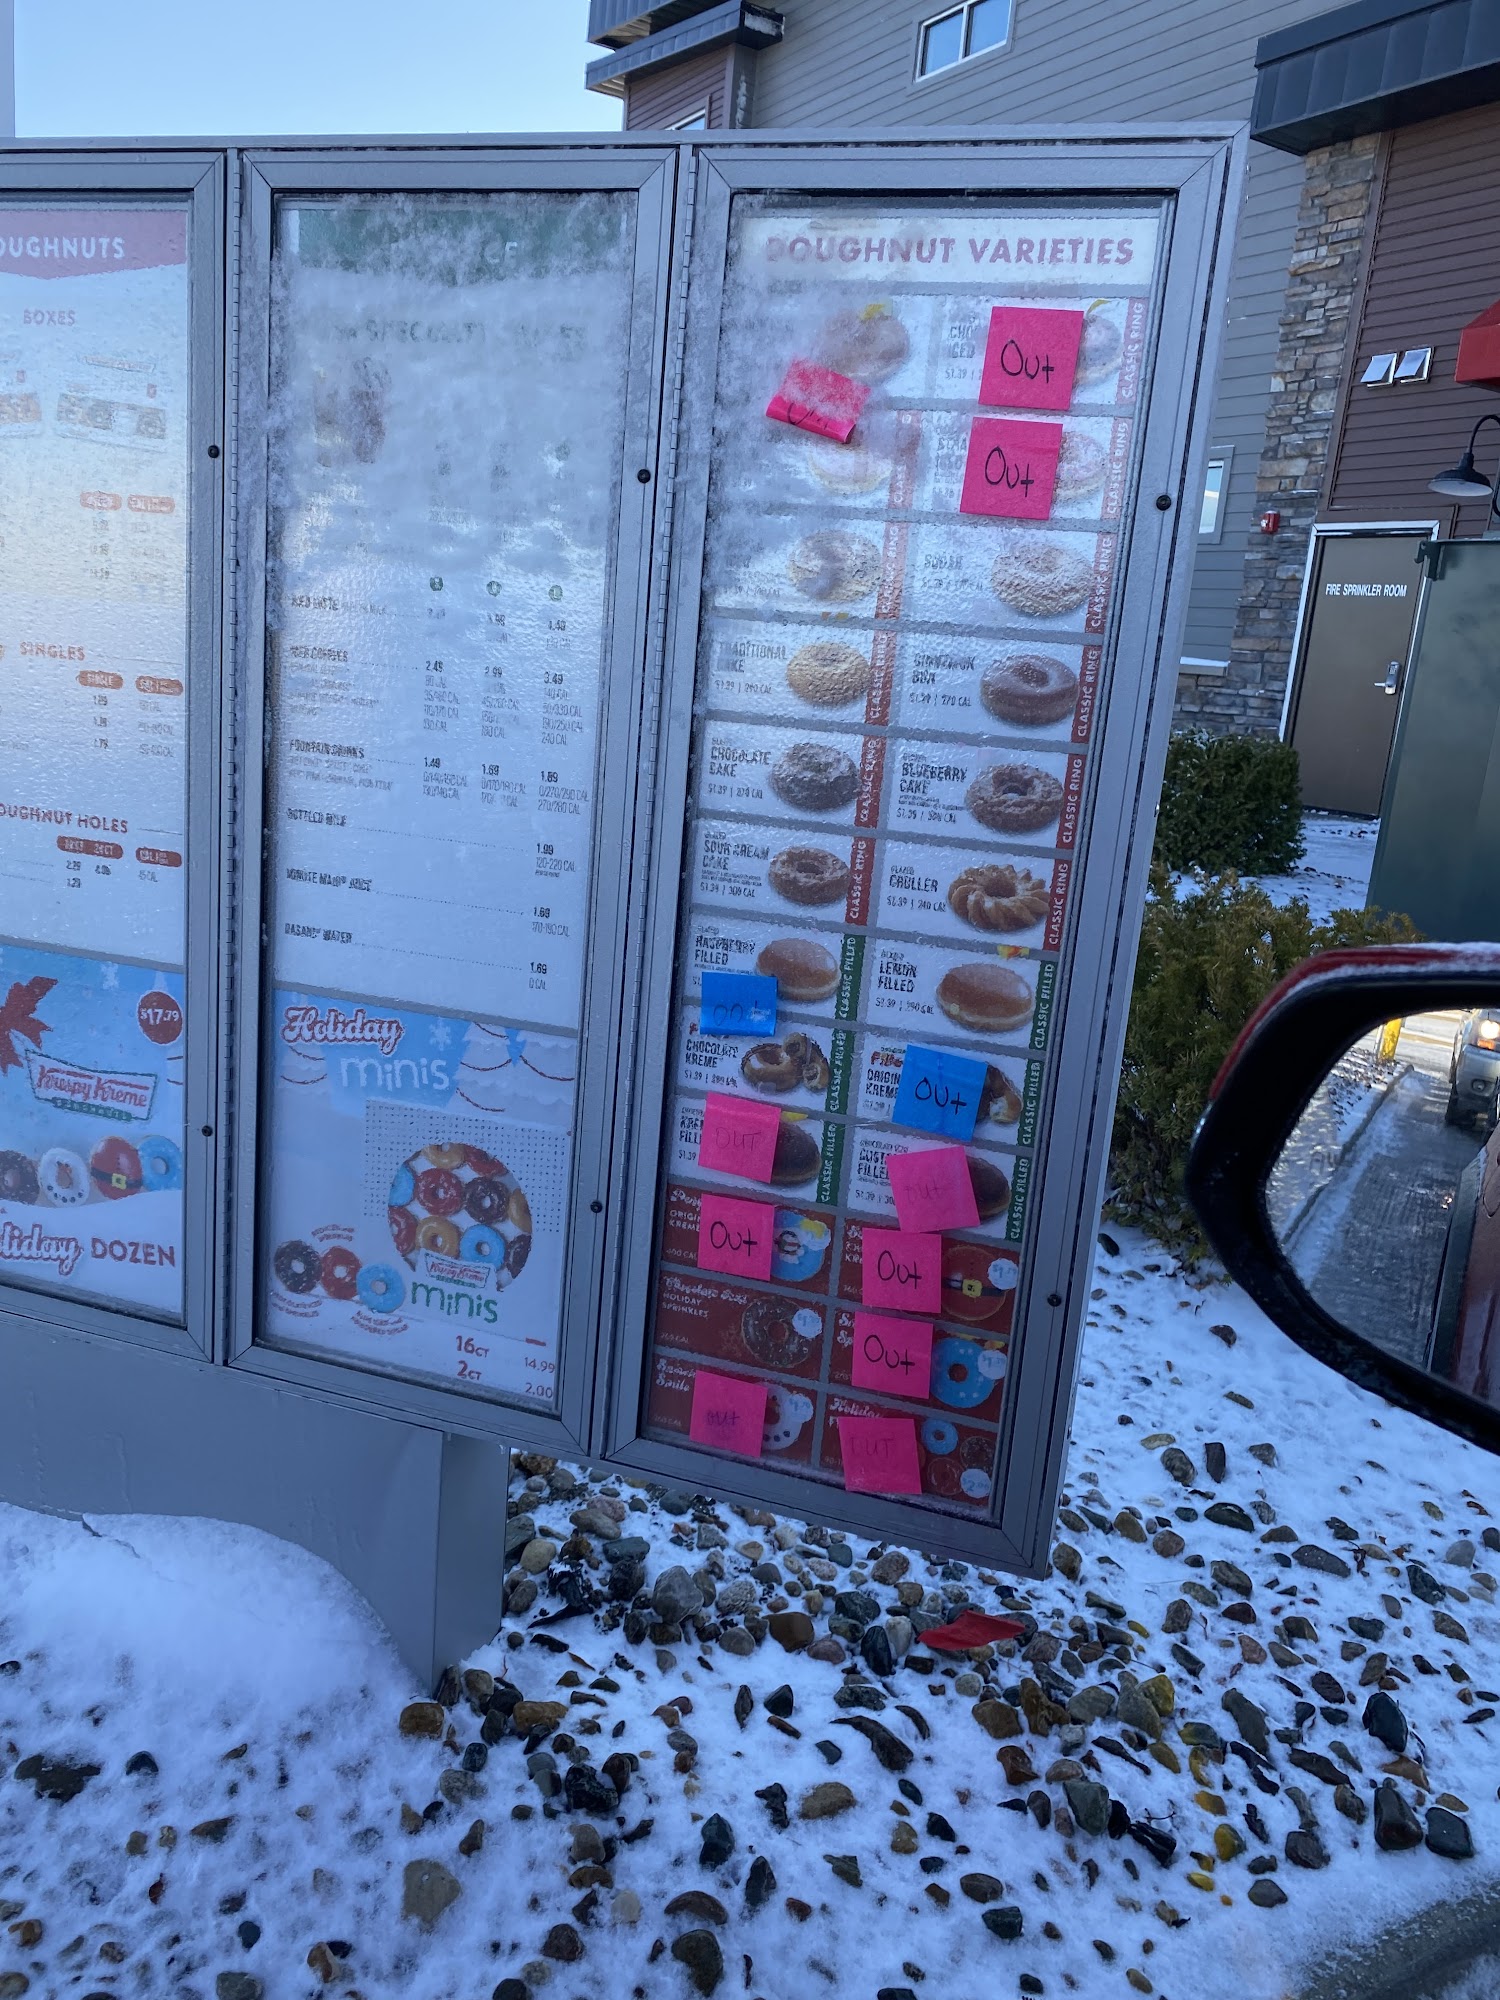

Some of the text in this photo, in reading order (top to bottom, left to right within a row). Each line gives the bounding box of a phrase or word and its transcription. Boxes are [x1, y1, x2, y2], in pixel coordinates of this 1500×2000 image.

[767, 236, 1137, 266] DOUGHNUT VARIETIES
[24, 308, 77, 326] BOXES
[1000, 339, 1054, 384] Out
[984, 446, 1034, 498] Out
[1090, 536, 1112, 628] CLASSIC RING
[1325, 583, 1408, 597] FIRE SPRINKLER ROOM
[20, 641, 86, 661] SINGLES
[1076, 650, 1099, 736] CLASSIC RING
[710, 747, 771, 765] CHOCOLATE
[708, 762, 738, 778] CAKE
[901, 763, 967, 782] BLUEBERRY
[899, 779, 928, 795] CAKE
[1062, 759, 1083, 843] CLASSIC RING
[77, 814, 129, 833] HOLES
[536, 842, 554, 856] 1.99
[703, 840, 730, 856] SOUR
[702, 855, 730, 870] CAKE
[889, 874, 939, 893] CRULLER
[1048, 863, 1069, 945] CLASSIC RING
[694, 949, 729, 966] FILLED
[879, 960, 918, 978] LEMON
[877, 975, 915, 993] FILLED
[838, 975, 854, 1019] CLASSIC
[1034, 964, 1055, 1050] CLASSIC FILLED
[280, 1006, 405, 1056] Holiday
[686, 1038, 739, 1059] CHOCOLATE
[685, 1052, 718, 1068] KREME
[340, 1058, 450, 1091] minis
[867, 1068, 901, 1084] ORIGIN
[35, 1064, 149, 1107] Krispy Kreme
[1023, 1060, 1042, 1145] CLASSIC FILLED
[678, 1149, 697, 1161] $1.39
[821, 1123, 837, 1203] CLASSIC FILLED
[1010, 1158, 1029, 1240] CLASSIC FILLED
[710, 1221, 758, 1257] Out
[91, 1237, 176, 1267] DOZEN
[877, 1250, 922, 1290] Out
[411, 1281, 498, 1324] minis
[662, 1292, 702, 1306] HOLIDAY
[661, 1301, 709, 1318] SPRINKLES
[864, 1334, 916, 1376] Out
[524, 1357, 556, 1374] 14.99
[525, 1382, 553, 1399] 2.00
